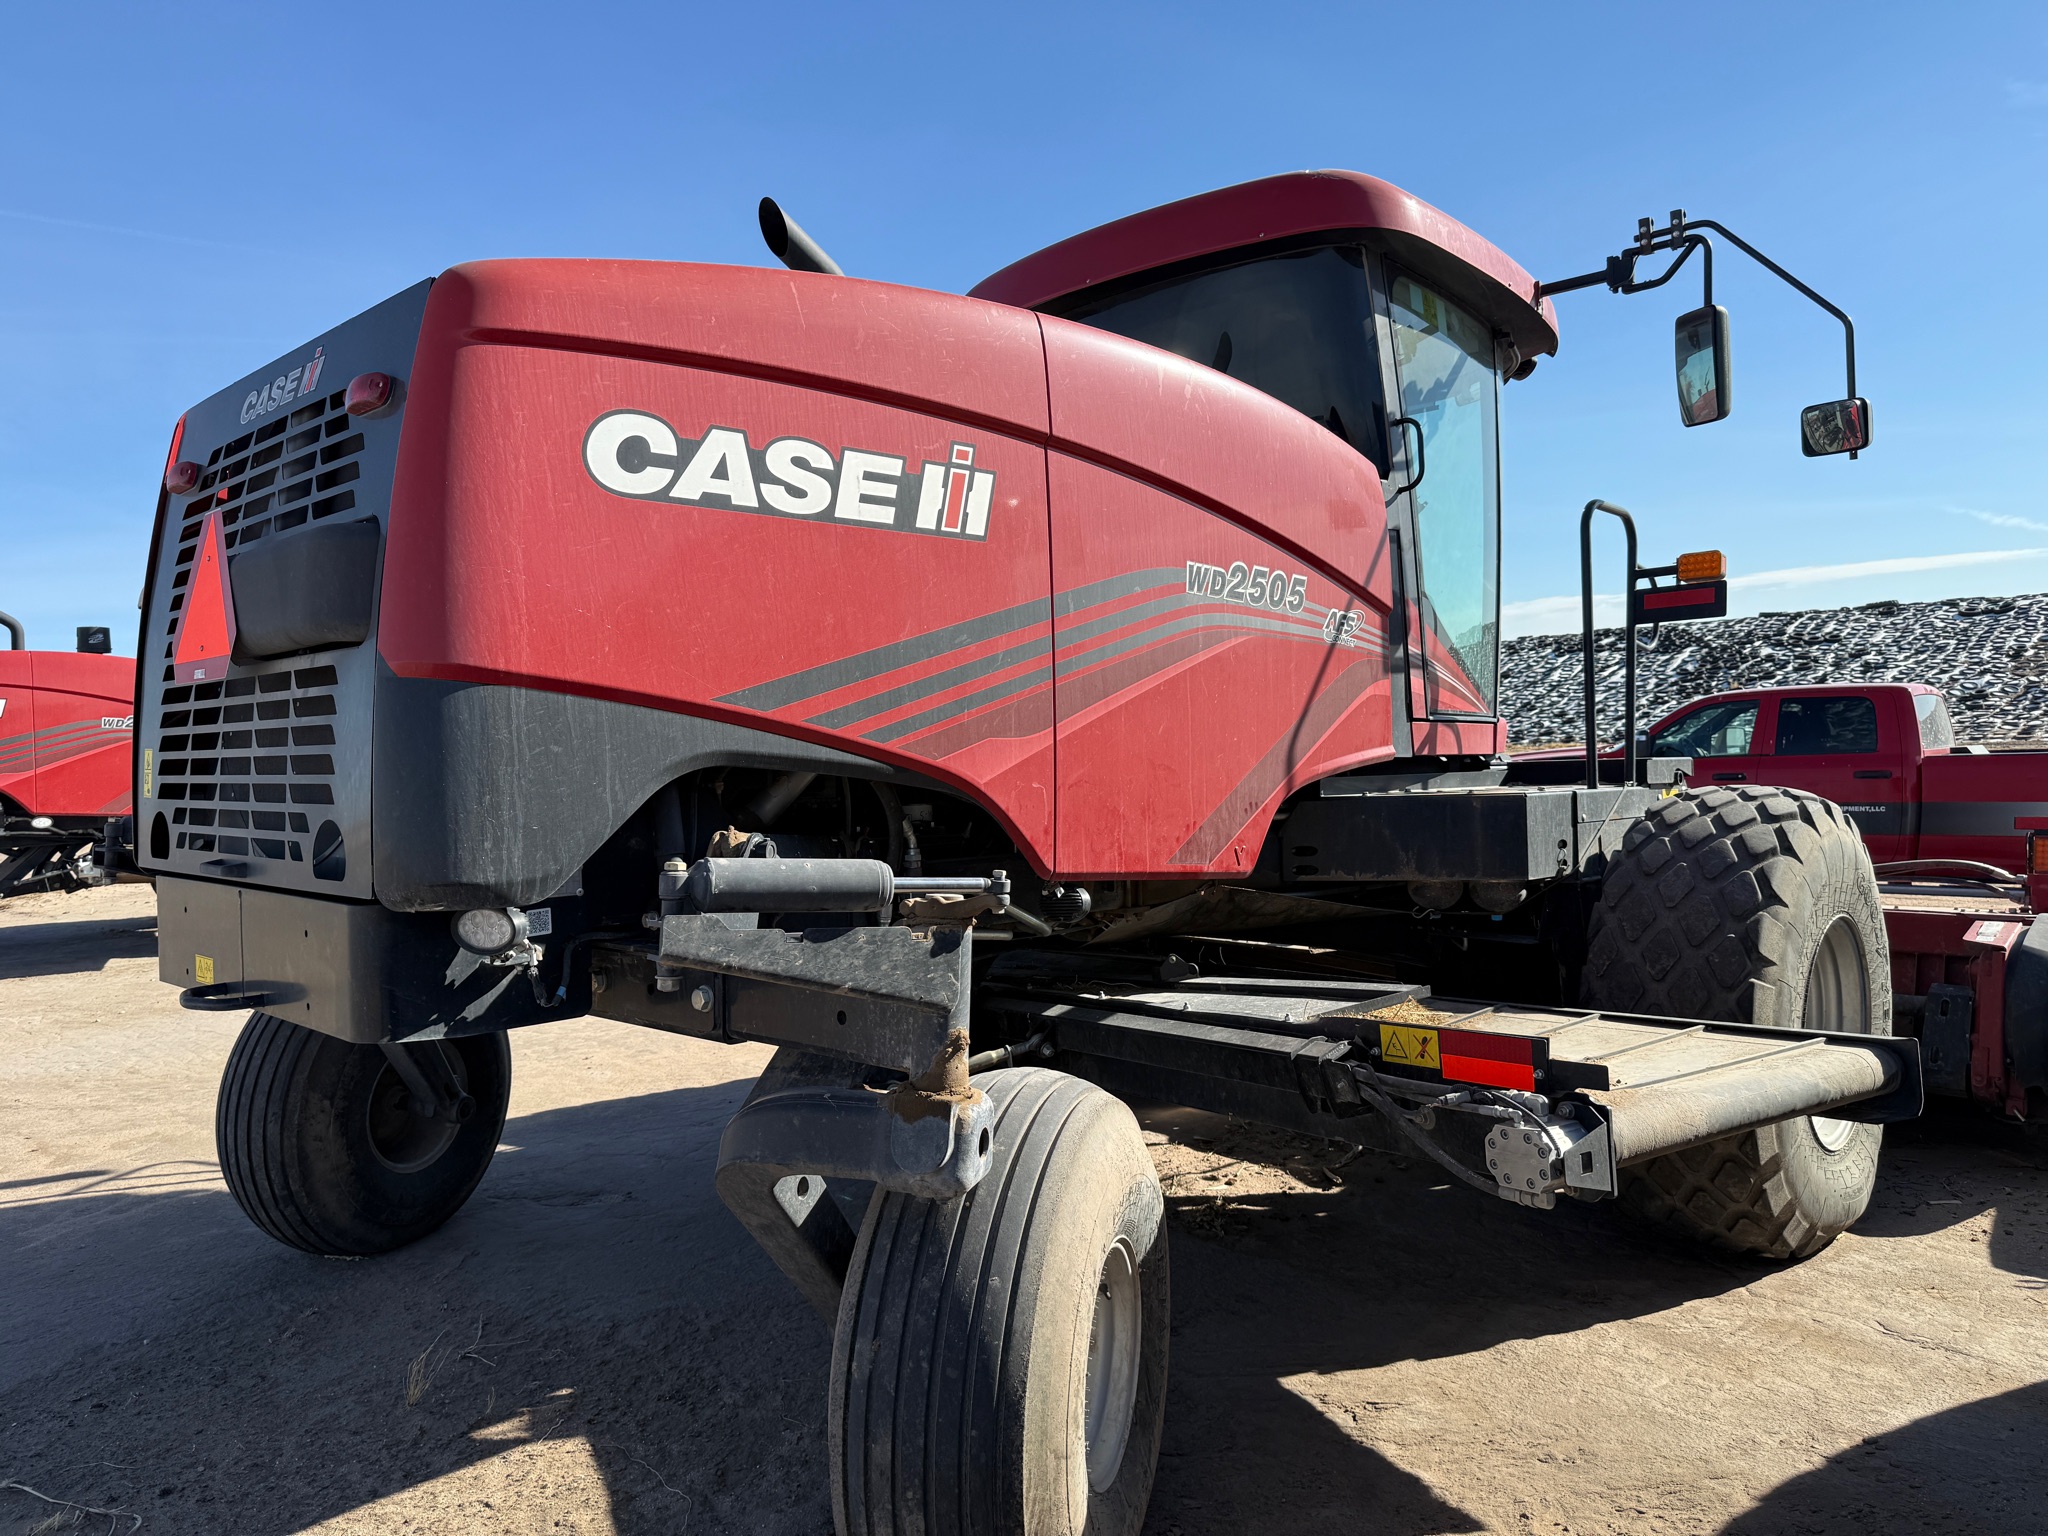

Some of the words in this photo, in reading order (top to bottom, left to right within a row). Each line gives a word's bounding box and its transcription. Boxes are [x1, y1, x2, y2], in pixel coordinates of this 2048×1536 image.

[240, 367, 302, 425] CASE
[585, 412, 902, 526] CASE
[1186, 560, 1307, 613] WD2505
[1322, 608, 1358, 636] AFS
[101, 715, 134, 729] WD2
